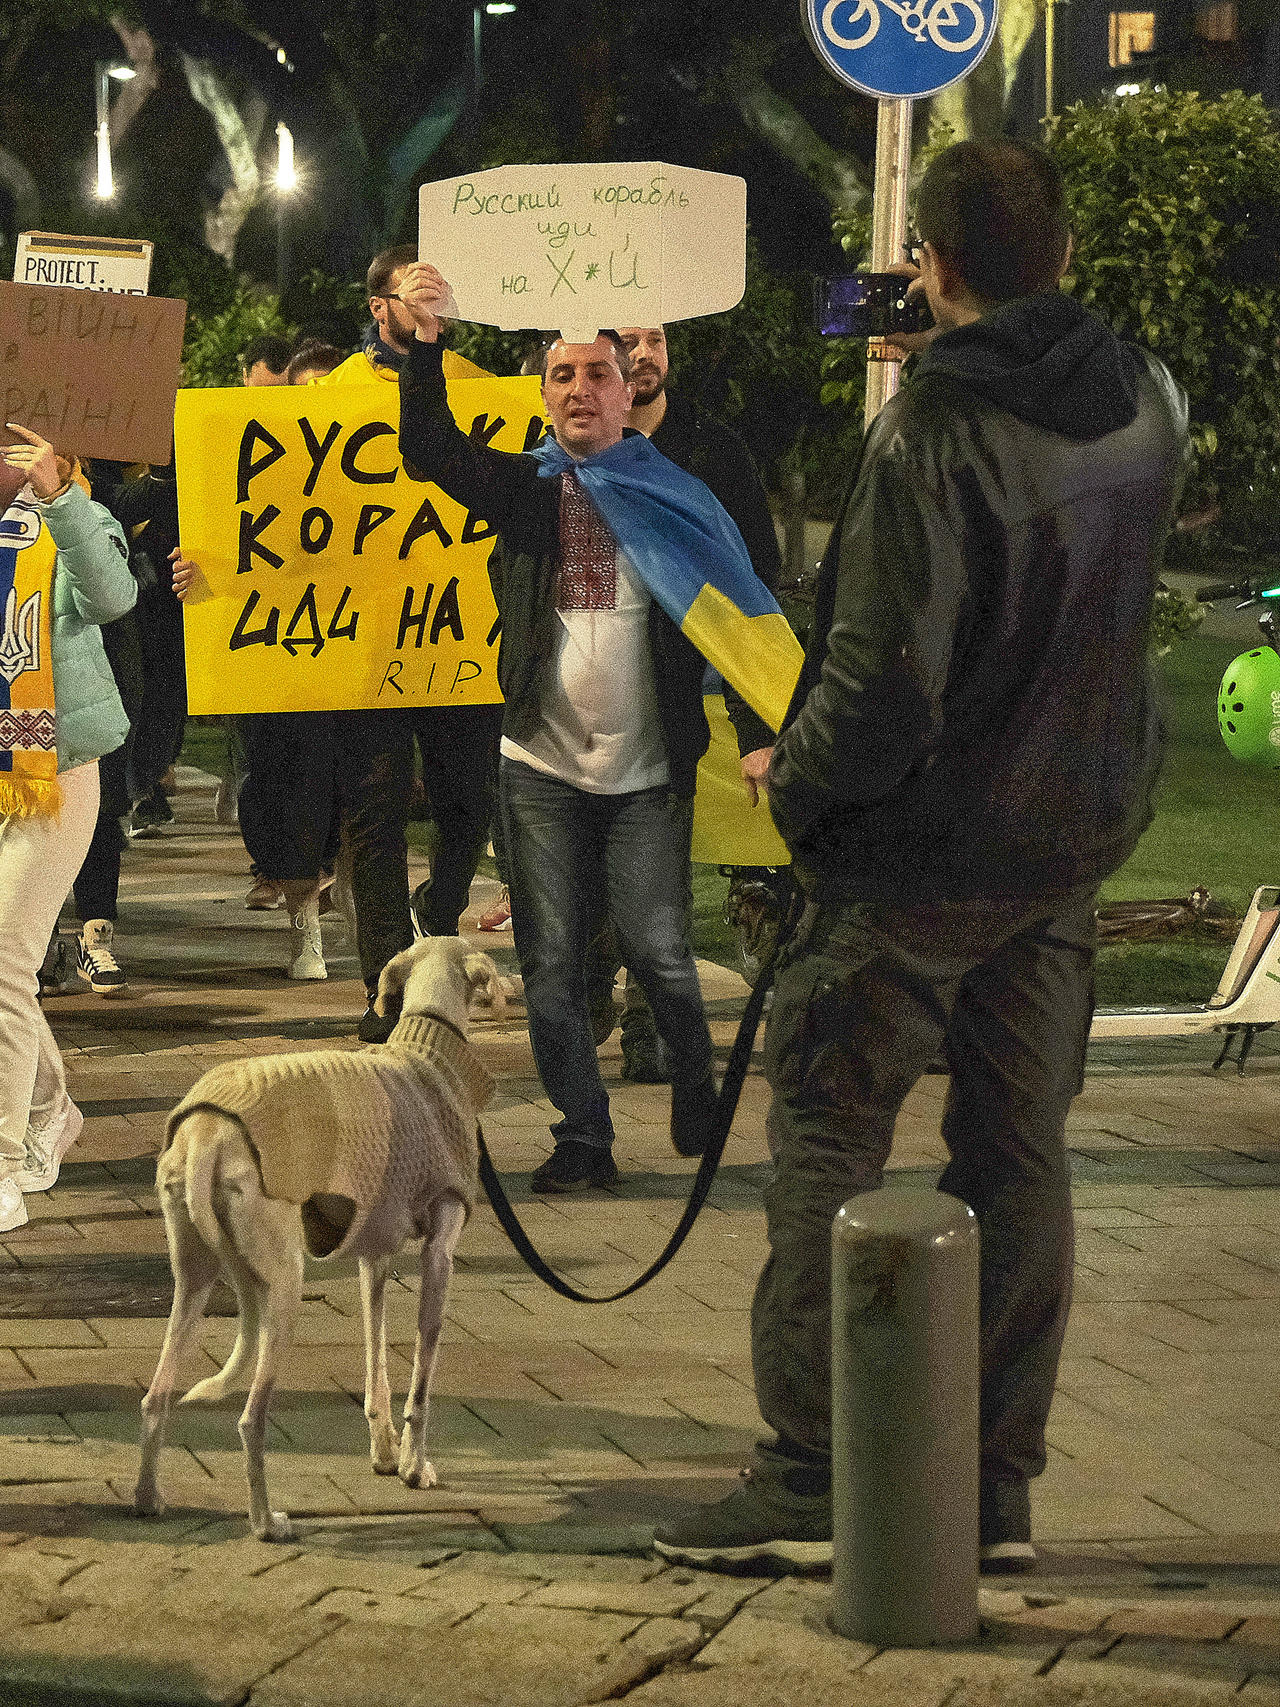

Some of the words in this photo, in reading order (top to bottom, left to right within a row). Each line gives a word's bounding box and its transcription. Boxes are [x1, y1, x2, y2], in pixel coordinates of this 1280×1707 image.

[453, 183, 562, 215] Русский
[593, 177, 690, 218] корабль
[537, 220, 597, 249] иди
[501, 274, 533, 295] на
[229, 583, 360, 658] ИДИ
[396, 576, 465, 649] НА
